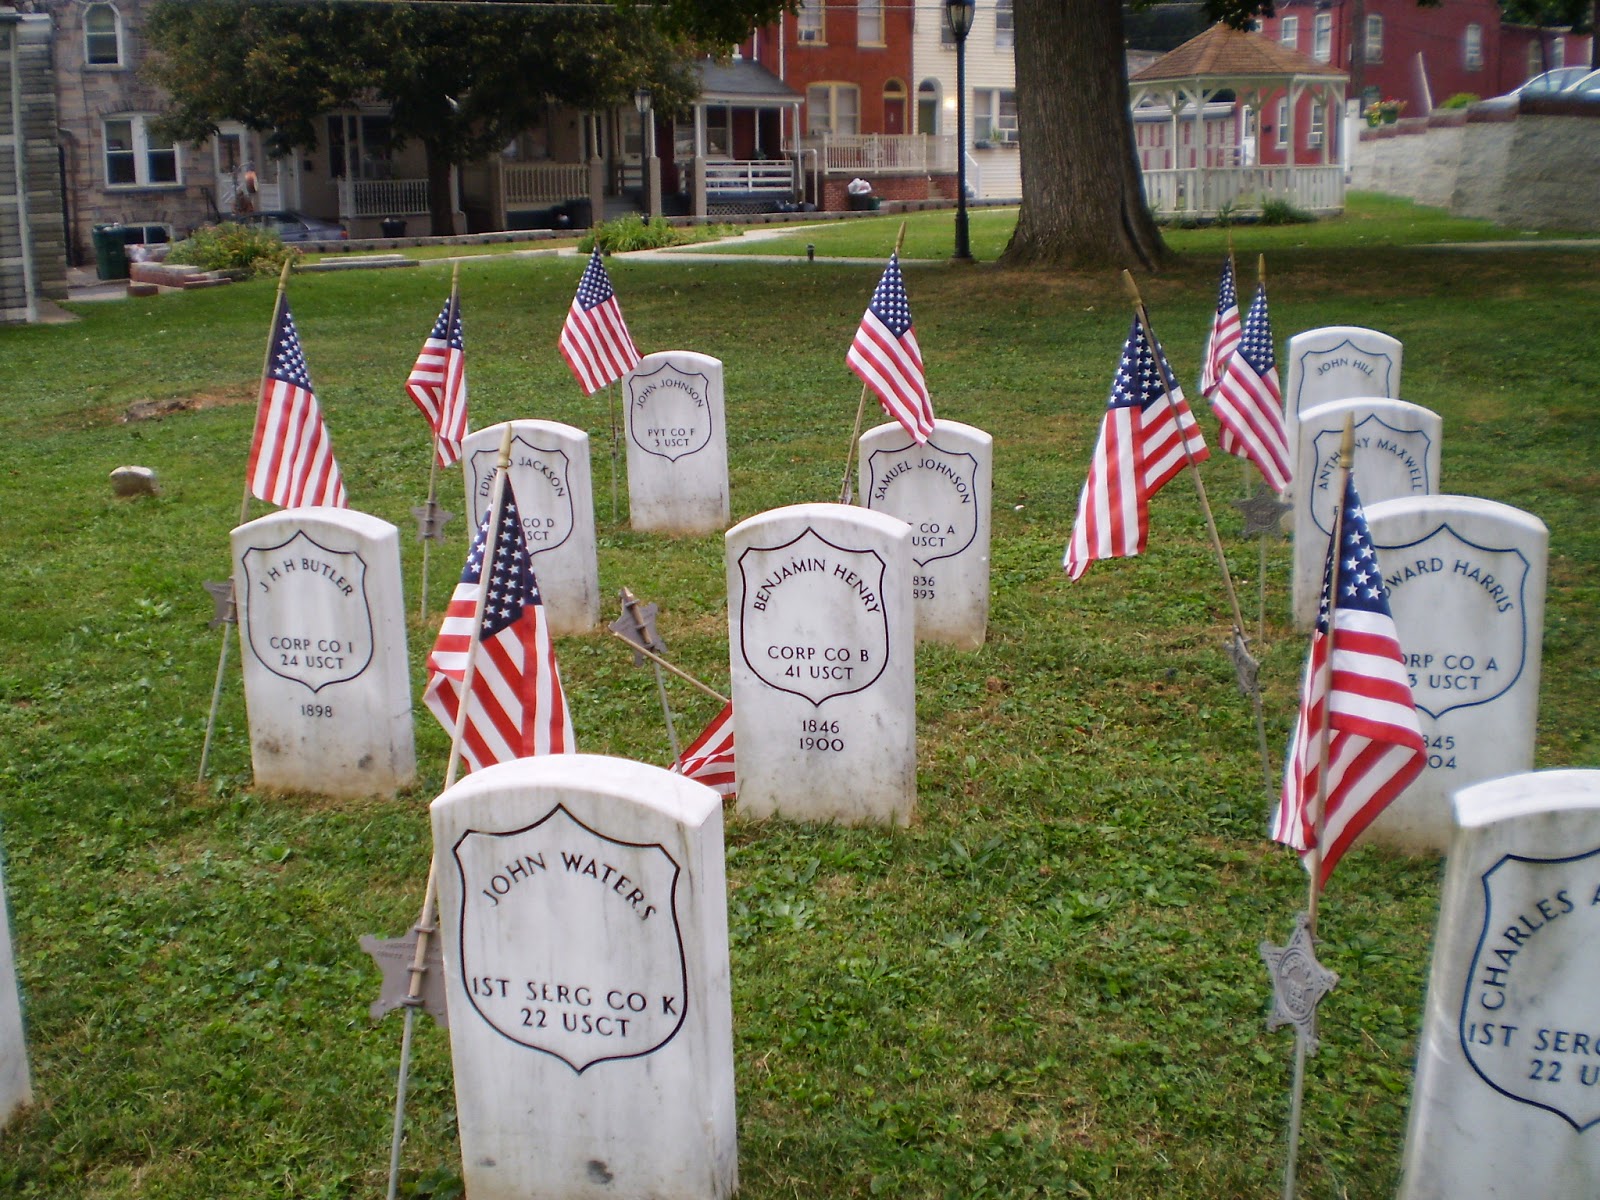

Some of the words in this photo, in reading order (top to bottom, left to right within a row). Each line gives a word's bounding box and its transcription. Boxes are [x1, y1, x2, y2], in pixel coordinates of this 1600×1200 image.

[1316, 358, 1349, 377] JOHN
[1352, 359, 1375, 378] HILL
[636, 383, 657, 408] JOHN
[660, 379, 704, 408] JOHNSON
[648, 428, 667, 437] PVT
[670, 428, 686, 437] CO
[690, 428, 695, 436] F
[655, 438, 660, 447] 3
[665, 438, 690, 447] USCT
[1318, 437, 1370, 491] ANTHNY
[1377, 438, 1423, 491] MAXWELL
[480, 458, 513, 497] EDWAD
[518, 457, 565, 497] JACKSON
[875, 460, 913, 501] SAMUEL
[918, 458, 971, 504] JOHNSON
[522, 518, 541, 528] CO
[547, 518, 555, 528] D
[920, 523, 940, 534] CO
[947, 524, 955, 534] A
[527, 530, 549, 541] SCT
[912, 536, 946, 548] USCT
[259, 580, 269, 593] J
[267, 567, 281, 582] H
[283, 559, 296, 573] H
[301, 557, 354, 597] BUTLER
[913, 576, 935, 587] 836
[1384, 557, 1444, 600] DWARD
[1454, 559, 1514, 613] HARRIS
[753, 558, 826, 611] BENJAMIN
[833, 563, 880, 614] HENRY
[913, 589, 935, 600] 893
[270, 636, 310, 650] CORP
[317, 639, 341, 653] CO
[281, 653, 298, 667] 24
[305, 656, 344, 670] USCT
[767, 645, 816, 660] CORP
[824, 647, 850, 662] CO
[860, 649, 869, 662] B
[1444, 655, 1475, 671] CO
[1486, 657, 1498, 671] A
[785, 664, 801, 678] 41
[810, 665, 854, 680] USCT
[1429, 675, 1482, 691] USCT
[300, 704, 333, 718] 1898
[802, 720, 840, 734] 1846
[799, 737, 844, 751] 1900
[1422, 735, 1456, 750] 845
[482, 853, 547, 908] JOHN
[560, 852, 657, 922] WATERS
[1481, 889, 1574, 1011] CHARLES
[526, 981, 591, 1006] SERG
[606, 990, 647, 1012] CO
[662, 996, 678, 1016] K
[520, 1007, 547, 1028] 22
[562, 1012, 631, 1037] USCT
[1529, 1059, 1563, 1083] 22
